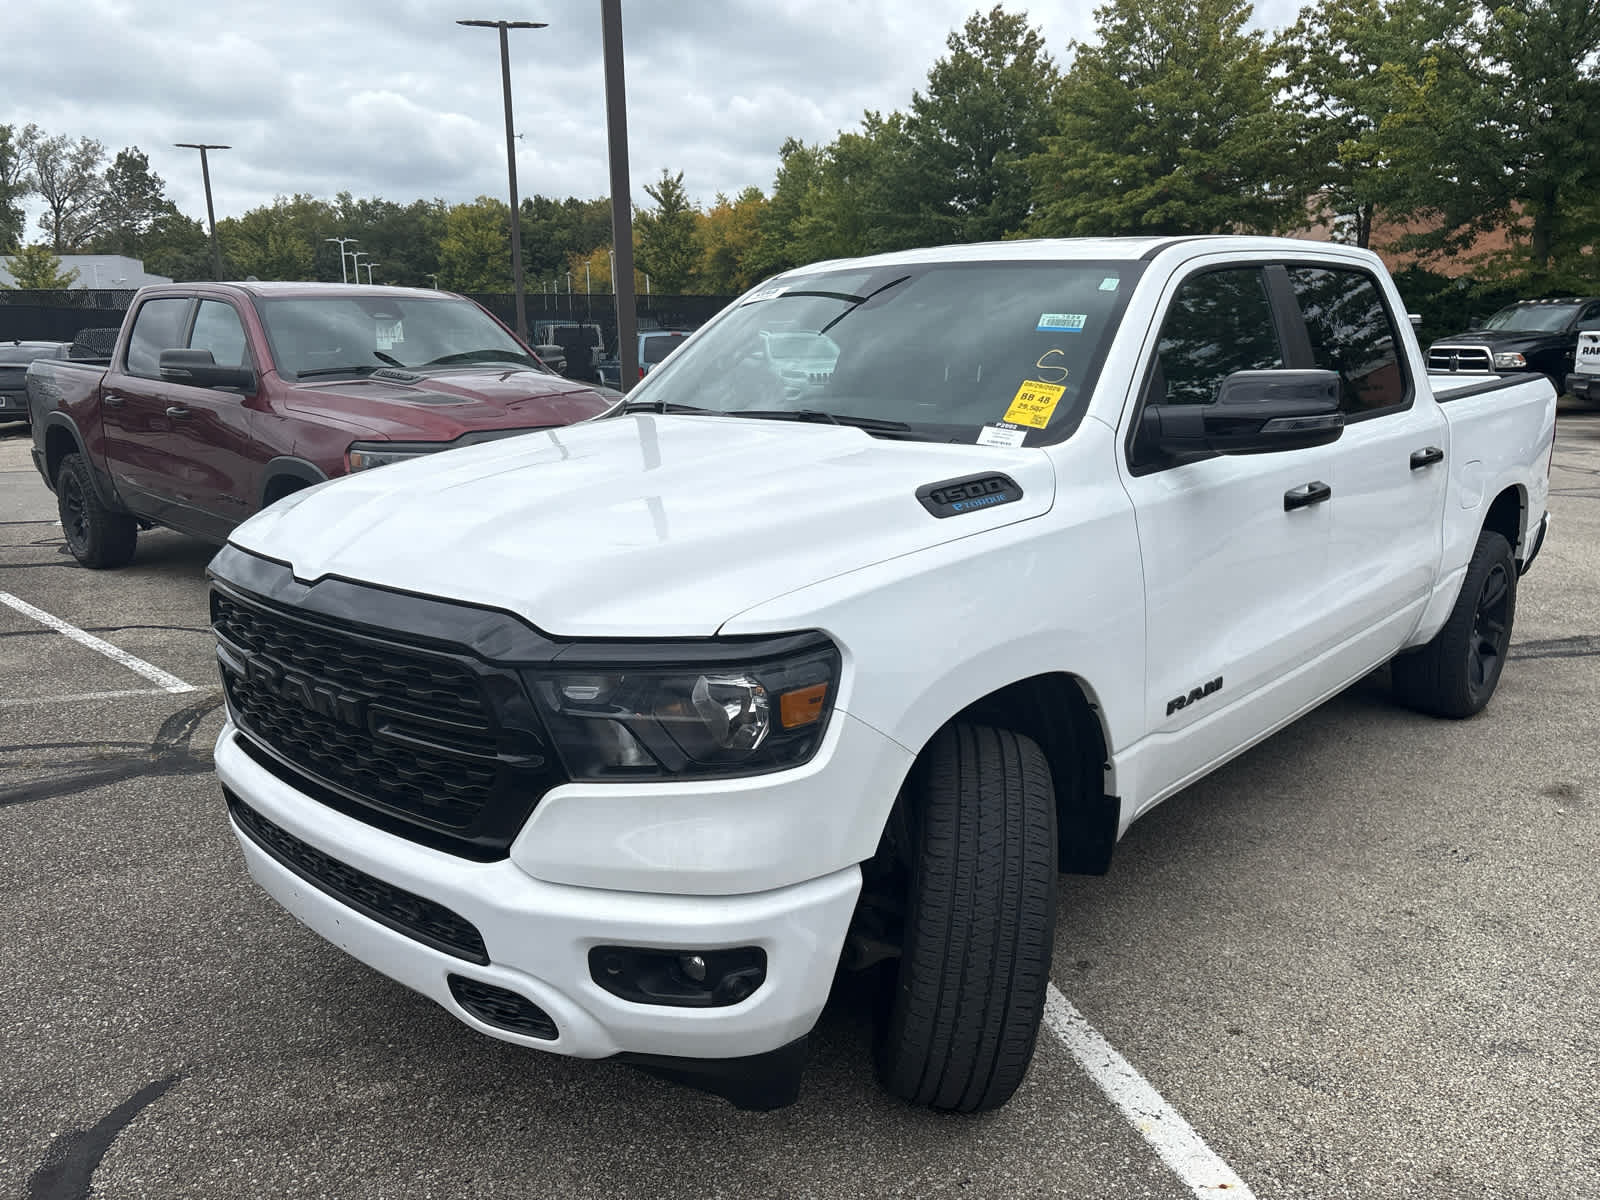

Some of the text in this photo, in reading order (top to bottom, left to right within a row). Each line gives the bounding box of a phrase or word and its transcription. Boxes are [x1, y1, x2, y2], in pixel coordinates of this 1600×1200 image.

[1583, 346, 1600, 356] RA
[1036, 349, 1069, 383] S
[930, 479, 1003, 504] 1500
[1166, 676, 1223, 717] RAM
